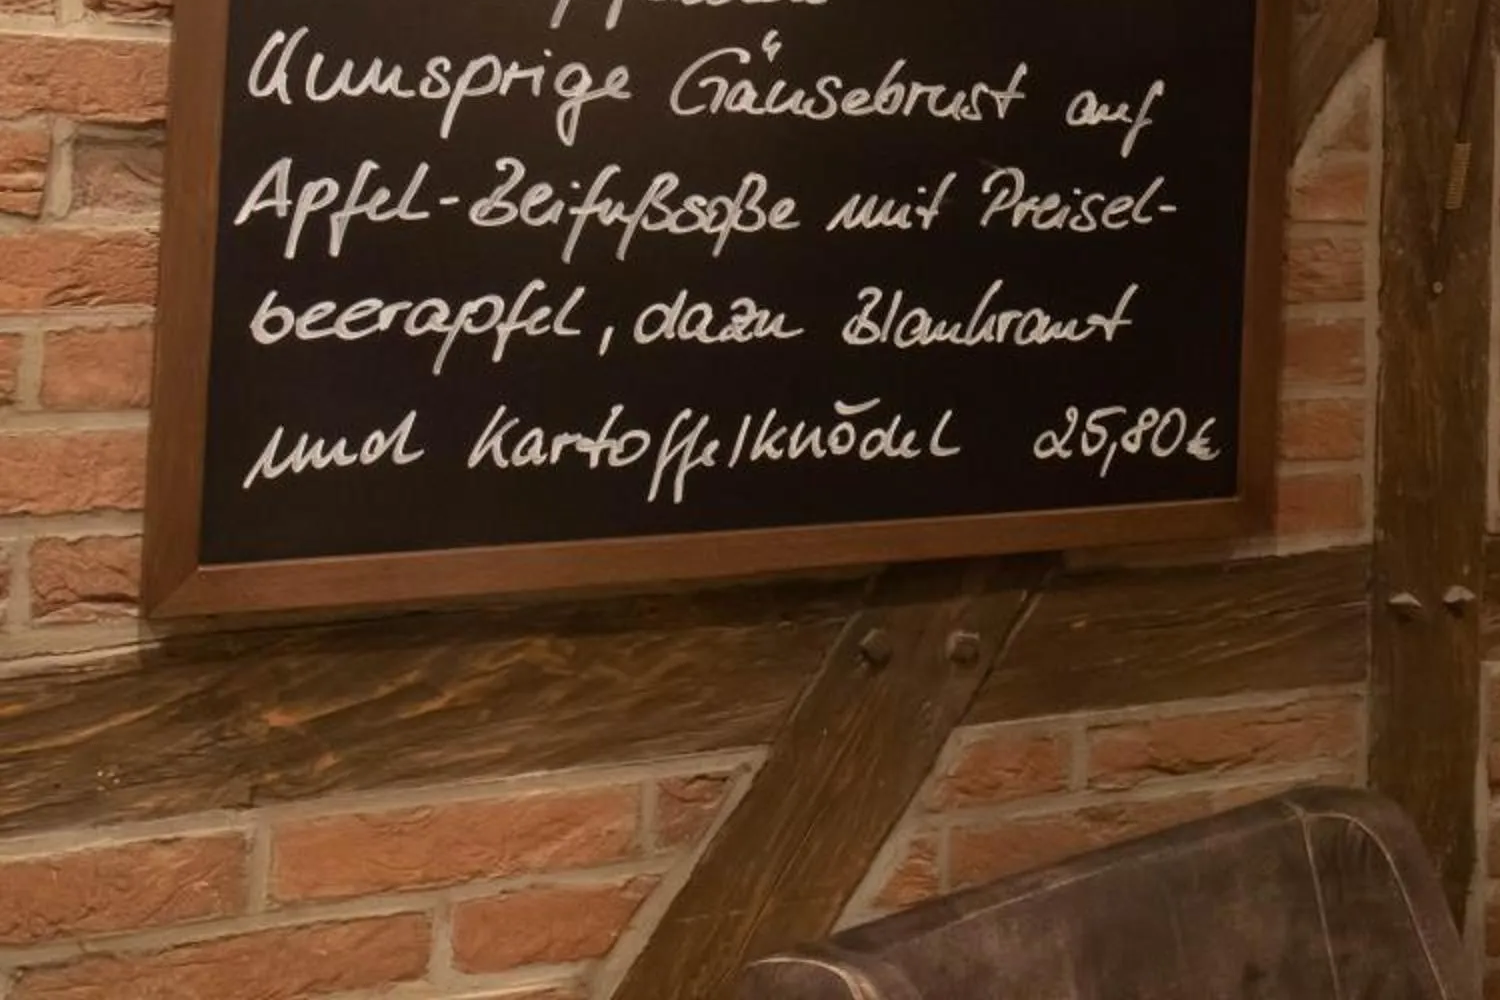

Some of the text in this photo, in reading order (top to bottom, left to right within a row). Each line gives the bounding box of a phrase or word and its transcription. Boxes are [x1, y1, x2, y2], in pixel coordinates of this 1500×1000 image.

[247, 25, 1165, 159] Knusprige Gänsebrust auf
[825, 171, 958, 232] mit
[979, 166, 1177, 233] Preisel-
[633, 288, 805, 345] dazu
[841, 278, 1139, 349] Blaukraut
[242, 409, 425, 490] und
[467, 397, 961, 505] Kartoffelknödel
